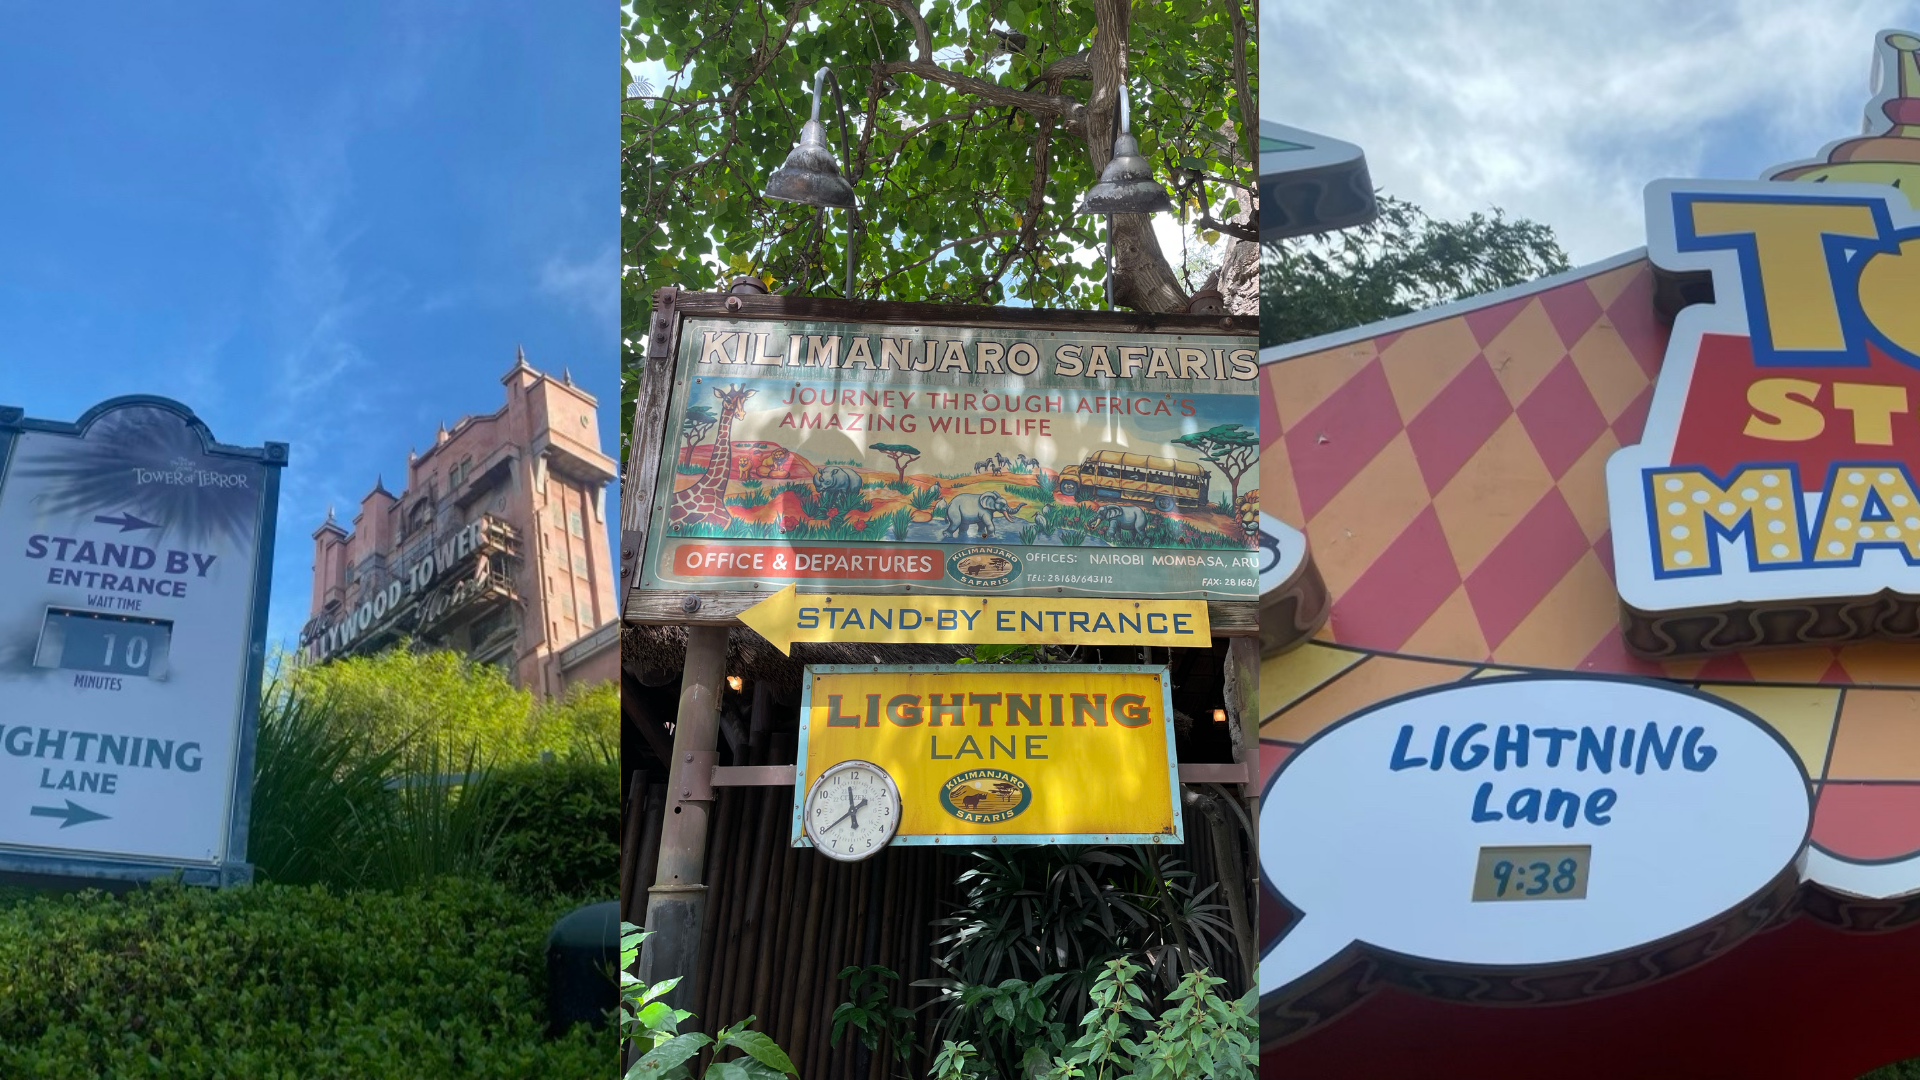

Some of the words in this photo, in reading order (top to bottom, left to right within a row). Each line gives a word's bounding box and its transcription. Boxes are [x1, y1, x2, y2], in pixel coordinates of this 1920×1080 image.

[699, 330, 1040, 375] KILIMANJARO
[1054, 343, 1259, 381] SAFARIS
[782, 387, 916, 410] JOURNEY
[927, 392, 1062, 414] THROUGH
[1076, 397, 1197, 417] AFRICA'S
[779, 412, 917, 434] AMAZING
[928, 416, 1052, 437] WILDLIFE
[132, 468, 185, 486] TOWER
[194, 469, 249, 488] TERROR
[26, 535, 156, 570] STAND
[165, 550, 217, 577] BY
[409, 519, 489, 595] TOWER
[686, 552, 764, 570] OFFICE
[772, 553, 787, 571] &
[794, 553, 933, 573] DEPARTURES
[952, 547, 1018, 562] KILIMANJARO
[1026, 552, 1078, 564] OFFICES:
[1089, 553, 1144, 565] NAIROBI
[1152, 554, 1228, 568] MOMBASA,
[47, 567, 187, 598] ENTRANCE
[961, 576, 1009, 587] SAFARIS
[1027, 573, 1046, 582] TEL:
[1202, 578, 1222, 587] FAX:
[87, 594, 115, 609] WAIT
[117, 597, 142, 611] TIME
[796, 607, 981, 631] STAND-BY
[996, 610, 1194, 634] ENTRANCE
[103, 633, 148, 669] 10
[74, 674, 122, 691] MINUTES
[827, 692, 1152, 729] LIGHTNING
[931, 734, 1049, 760] LANE
[1389, 721, 1719, 775] LIGHTNING
[40, 768, 118, 794] LANE
[833, 776, 840, 785] 11
[850, 771, 859, 780] 12
[945, 770, 1025, 790] KILIMANJARO
[820, 790, 829, 799] 10
[881, 788, 887, 798] 2
[816, 808, 822, 817] 9
[884, 807, 890, 816] 3
[1471, 782, 1617, 828] Lane
[956, 809, 1014, 822] SAFARIS
[819, 826, 826, 835] 8
[878, 824, 884, 833] 4
[831, 839, 837, 848] 7
[848, 844, 854, 853] 6
[866, 839, 872, 847] 5
[1493, 858, 1578, 897] 9:38
